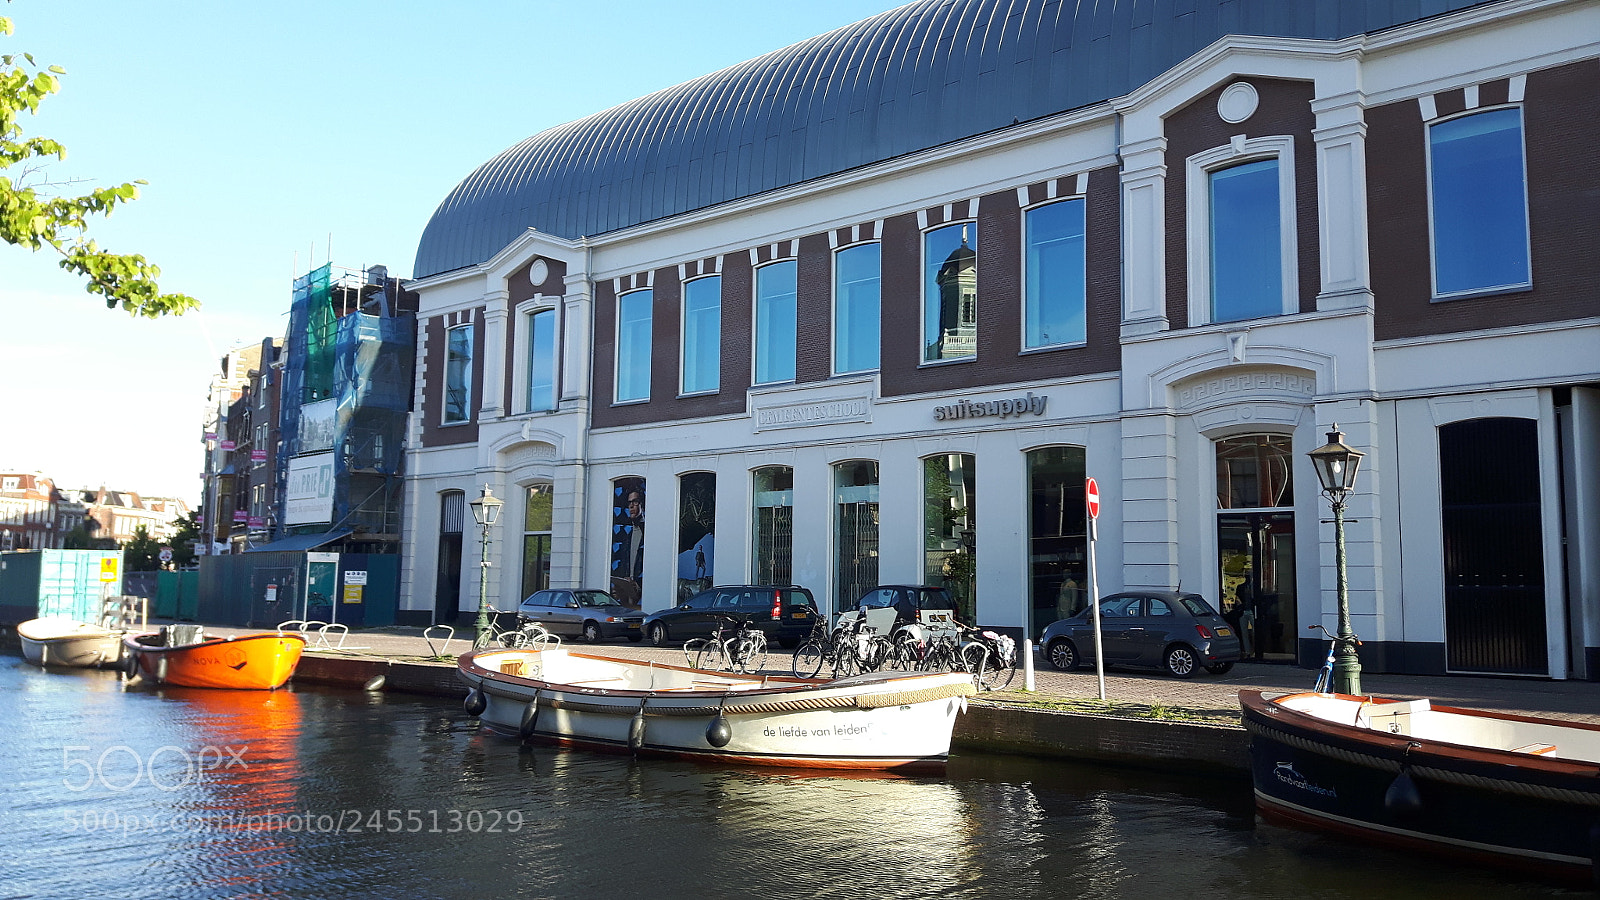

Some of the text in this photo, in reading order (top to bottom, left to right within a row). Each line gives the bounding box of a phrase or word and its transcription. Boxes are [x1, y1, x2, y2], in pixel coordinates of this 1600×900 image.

[933, 391, 1049, 422] suitsupply
[193, 657, 220, 666] NOVA
[763, 723, 868, 738] de liefde van leiden
